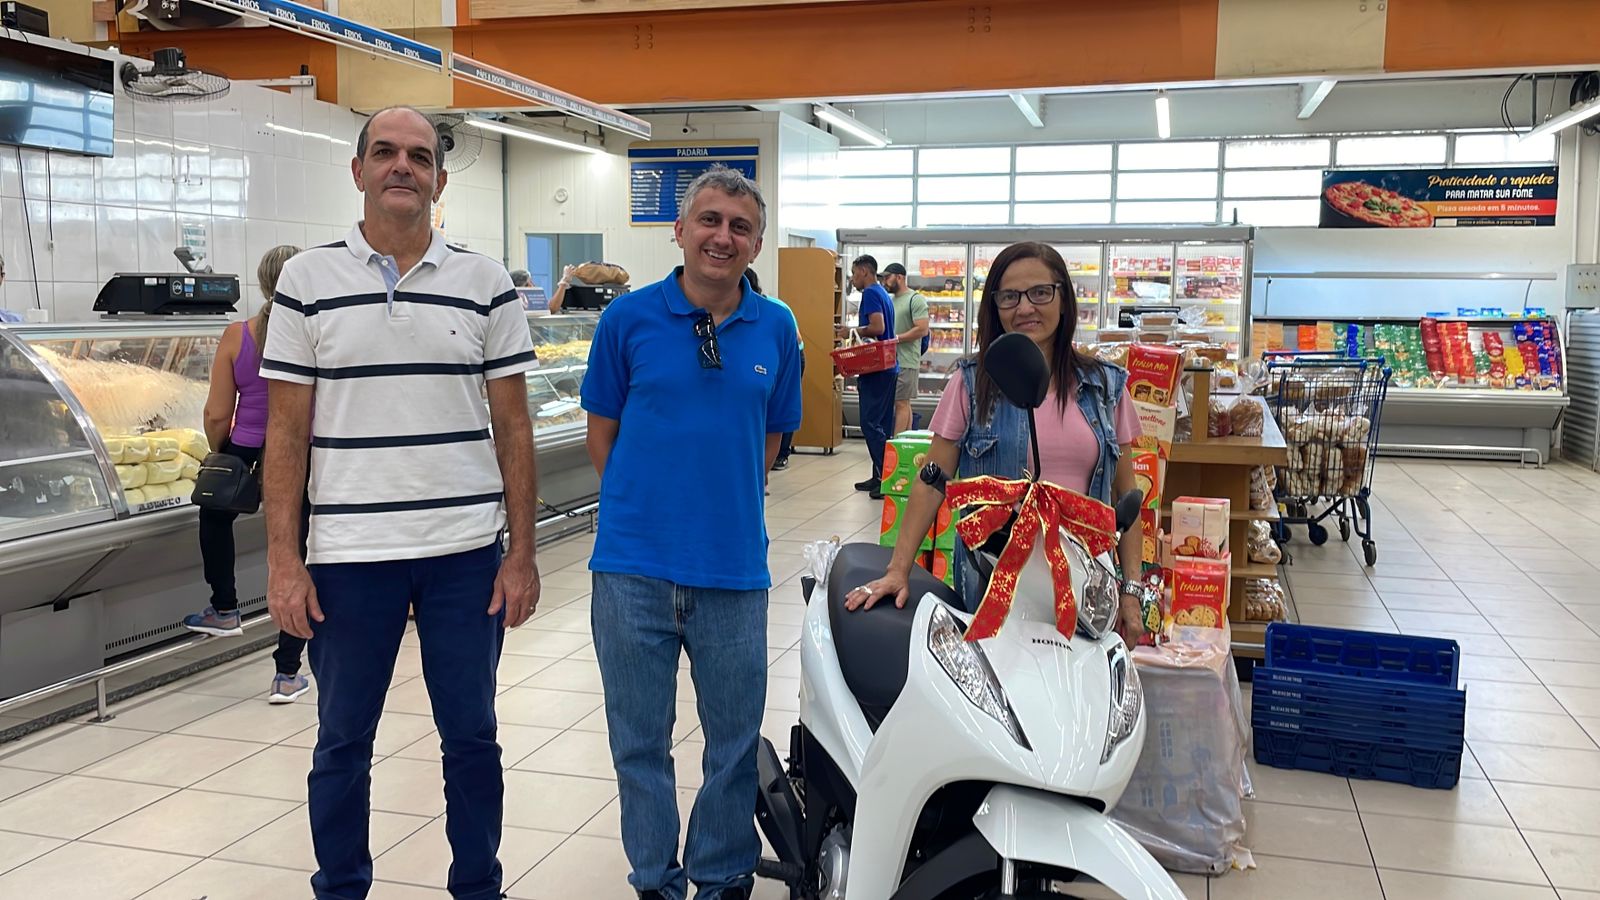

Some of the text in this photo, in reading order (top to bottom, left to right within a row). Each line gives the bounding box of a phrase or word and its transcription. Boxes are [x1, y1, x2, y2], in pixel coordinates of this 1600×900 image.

[276, 8, 296, 21] FRIOS
[312, 19, 330, 32] FRIOS
[344, 29, 362, 41] FRIOS
[375, 39, 392, 51] FRIOS
[404, 48, 420, 59] FRIOS
[676, 148, 709, 157] PADARIA
[1428, 173, 1555, 188] Praticidade e rapidez
[1445, 188, 1534, 199] PARA MATAR SUA FOME
[1437, 204, 1457, 212] Pizza
[1203, 584, 1219, 593] MIA
[1032, 638, 1073, 652] HONDA
